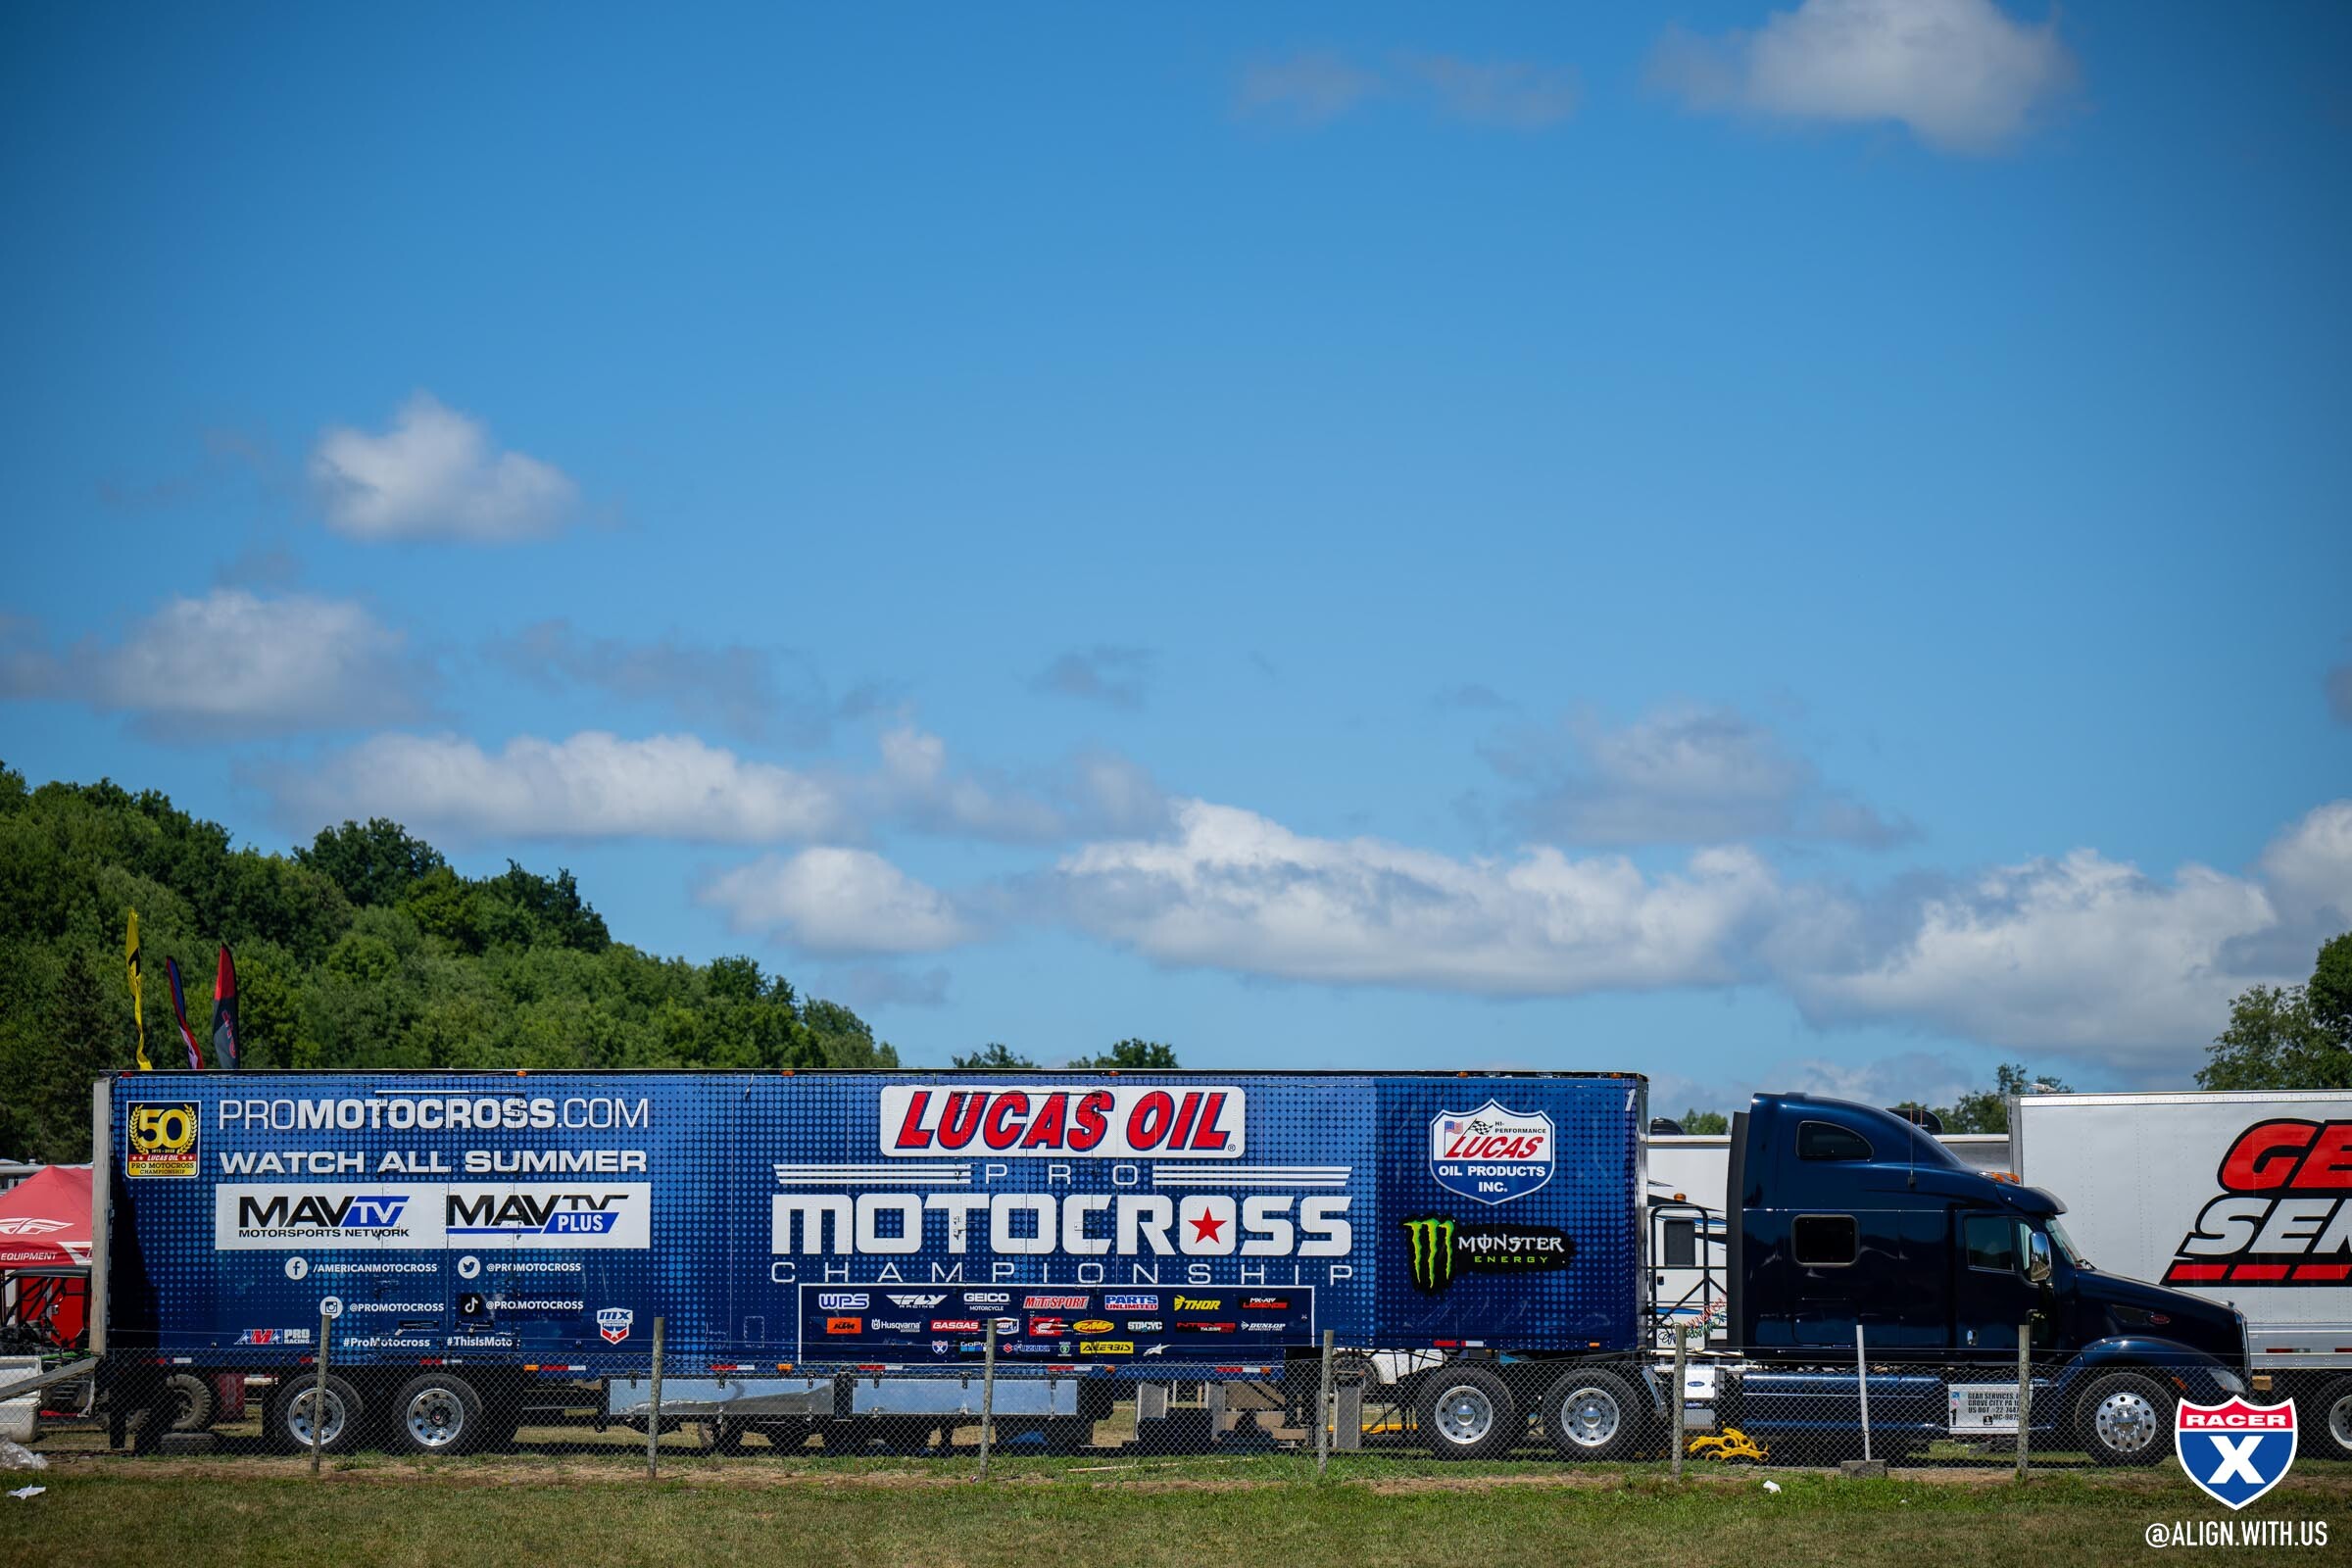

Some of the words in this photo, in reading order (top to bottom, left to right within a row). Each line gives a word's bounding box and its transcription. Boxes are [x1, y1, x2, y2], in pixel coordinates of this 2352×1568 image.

[219, 1098, 648, 1130] PROMOTOCROSS.COM
[894, 1091, 1115, 1152] LUCAS
[1126, 1091, 1232, 1152] OIL
[137, 1108, 191, 1149] 50
[1445, 1136, 1544, 1159] LUCAS
[220, 1152, 365, 1174] WATCH
[377, 1151, 452, 1173] ALL
[465, 1151, 648, 1173] SUMMER
[985, 1163, 1139, 1186] PRO
[1438, 1165, 1463, 1176] OIL
[1467, 1165, 1546, 1177] PRODUCTS
[1478, 1181, 1508, 1193] INC.
[558, 1214, 604, 1232] PLUS
[771, 1193, 1352, 1256] MOTOCROSS
[238, 1229, 341, 1238] MOTORSPORTS
[345, 1228, 410, 1238] NETWORK
[1458, 1234, 1565, 1253] MONSTER
[1, 1251, 58, 1261] EQUIPMENT
[313, 1263, 438, 1273] /AMERICANMOTOCROSS
[486, 1262, 581, 1272] @PROMOTOCROSS
[770, 1261, 1353, 1286] CHAMPIONSHIP
[819, 1294, 869, 1309] WPS
[963, 1293, 1009, 1302] GEICO
[1104, 1295, 1157, 1303] PARTS
[349, 1302, 445, 1312] @PROMOTOCROSS
[1184, 1299, 1221, 1309] THOR
[881, 1321, 920, 1331] Husqvarna
[233, 1328, 283, 1345] AMA
[284, 1328, 311, 1339] PRO
[343, 1337, 430, 1348] #ProMotocross
[447, 1337, 513, 1348] #ThisIsMoto
